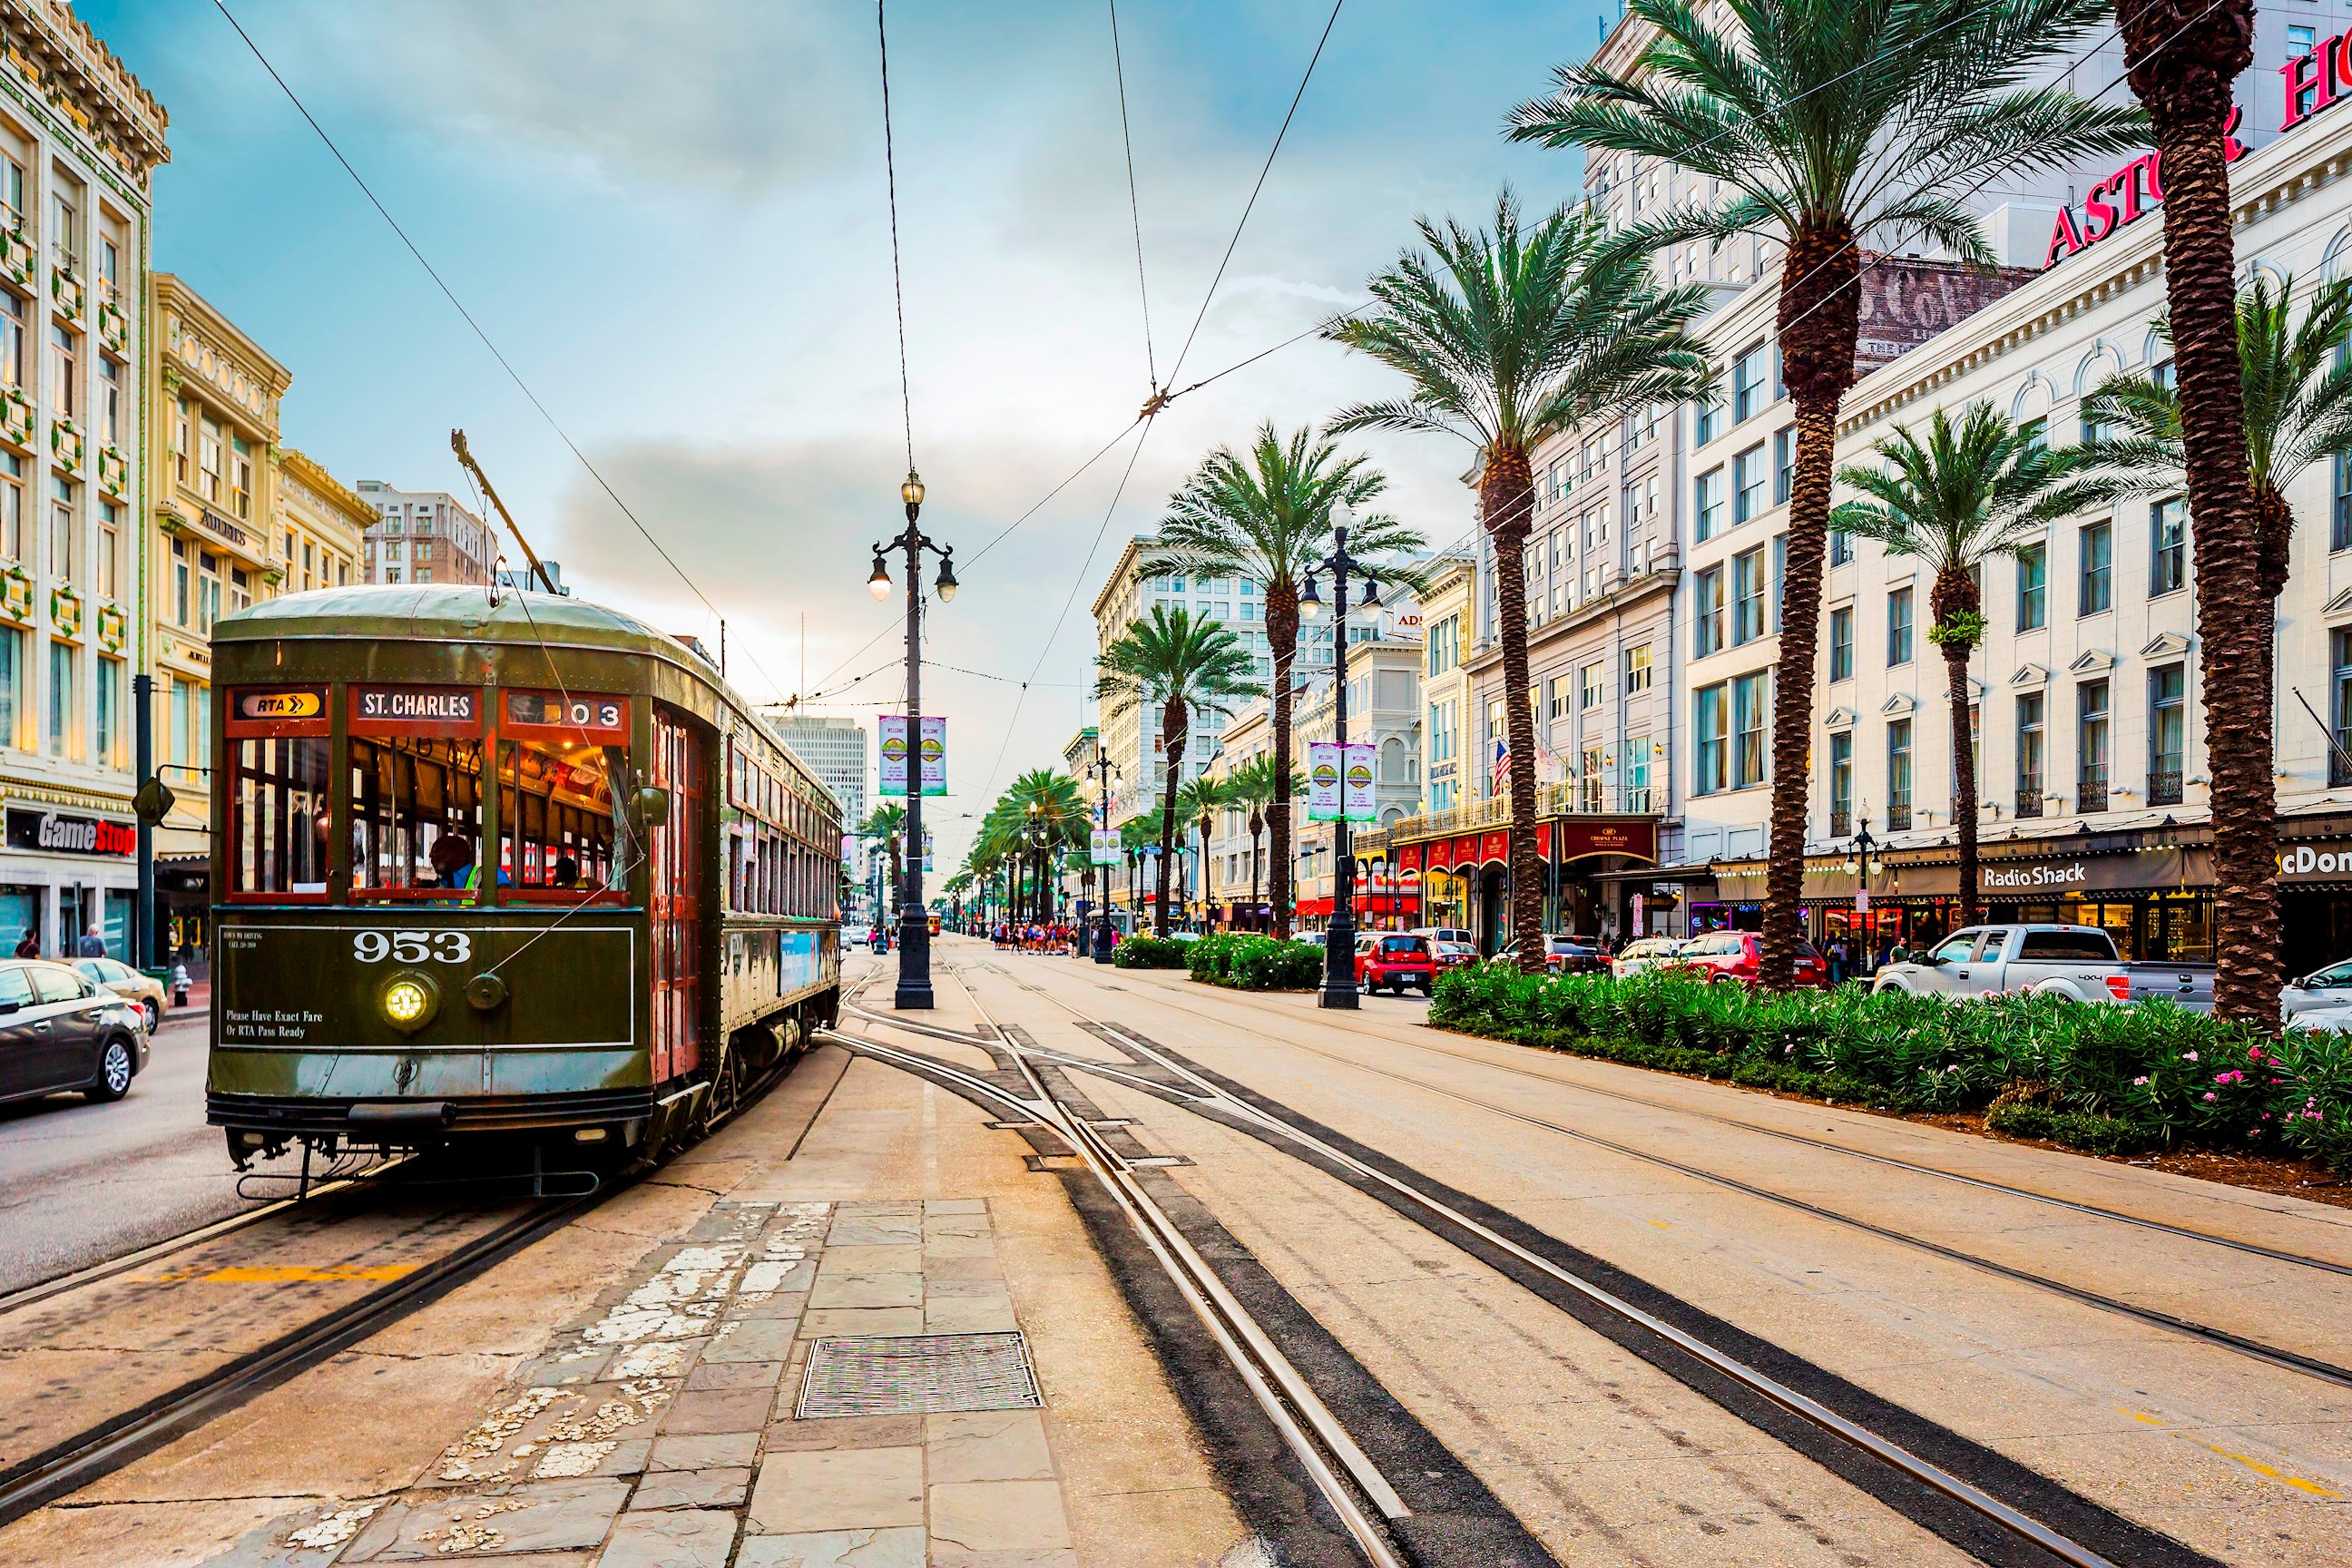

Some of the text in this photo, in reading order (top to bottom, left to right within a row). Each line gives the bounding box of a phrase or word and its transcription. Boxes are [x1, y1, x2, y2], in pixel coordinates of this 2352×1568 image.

[2278, 24, 2352, 132] H
[257, 700, 284, 712] RTA
[365, 693, 469, 717] ST. CHARLES
[38, 814, 136, 857] GameStop
[2275, 846, 2352, 875] cDon
[1984, 863, 2086, 887] Radio Shack
[353, 932, 472, 963] 953
[226, 1009, 323, 1023] Please Have Exact Fare
[226, 1024, 306, 1040] Or RTA Pass Ready
